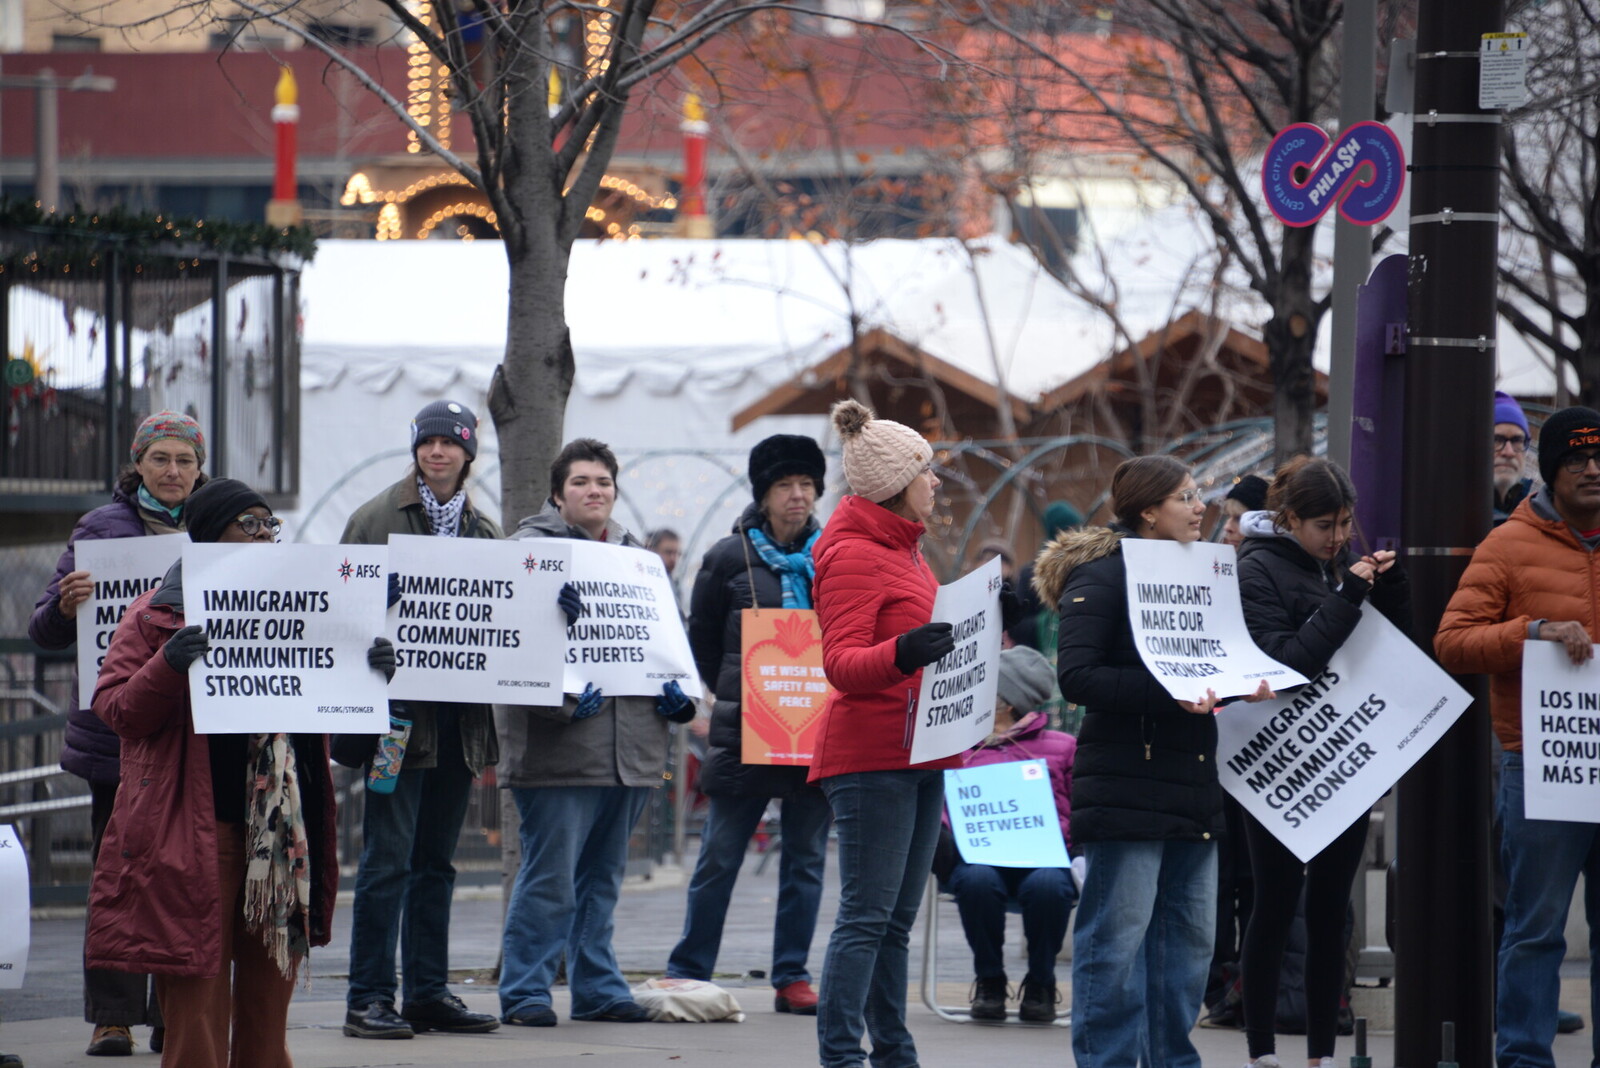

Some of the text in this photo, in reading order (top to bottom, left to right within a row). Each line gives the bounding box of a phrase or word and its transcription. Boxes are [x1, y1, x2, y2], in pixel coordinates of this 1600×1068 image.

[1272, 139, 1306, 210] CENTER CITY LOOP
[1308, 138, 1361, 206] PHLASH
[356, 565, 380, 578] AFSC
[539, 560, 564, 572] AFSC
[1221, 563, 1234, 576] AFSC
[401, 576, 513, 599] IMMIGRANTS
[1137, 583, 1212, 606] IMMIGRANTS
[203, 590, 329, 612] IMMIGRANTS
[399, 600, 492, 622] MAKE OUR
[579, 603, 660, 621] N NUESTRAS
[206, 618, 260, 640] MAKE
[264, 619, 305, 640] OUR
[1141, 610, 1204, 632] MAKE OUR
[397, 625, 520, 648] COMMUNITIES
[1145, 636, 1227, 658] COMMUNITIES
[204, 647, 334, 669] COMMUNITIES
[396, 649, 487, 671] STRONGER
[582, 647, 644, 663] FUERTES
[934, 640, 978, 675] MAKE OUR
[759, 665, 776, 676] WE
[779, 665, 807, 677] WISH
[1155, 661, 1223, 678] STRONGER
[205, 675, 303, 696] STRONGER
[497, 680, 550, 688] AFSC.ORG/STRONGER
[764, 681, 826, 693] SAFETY AND
[931, 661, 986, 701] COMMUNITIES
[779, 696, 812, 707] PEACE
[926, 694, 974, 728] STRONGER
[1540, 690, 1600, 711] LOS IN
[1227, 666, 1340, 776] IMMIGRANTS
[1541, 715, 1600, 735] HACEN
[1246, 703, 1342, 794] MAKE OUR
[1265, 693, 1387, 810] COMMUNITIES
[1542, 740, 1600, 759] COMU
[1543, 760, 1600, 785] MÁS F
[958, 785, 981, 800] NO
[1283, 742, 1377, 828] STRONGER
[961, 799, 1019, 817] WALLS
[965, 815, 1044, 834] BETWEEN
[968, 837, 991, 847] US
